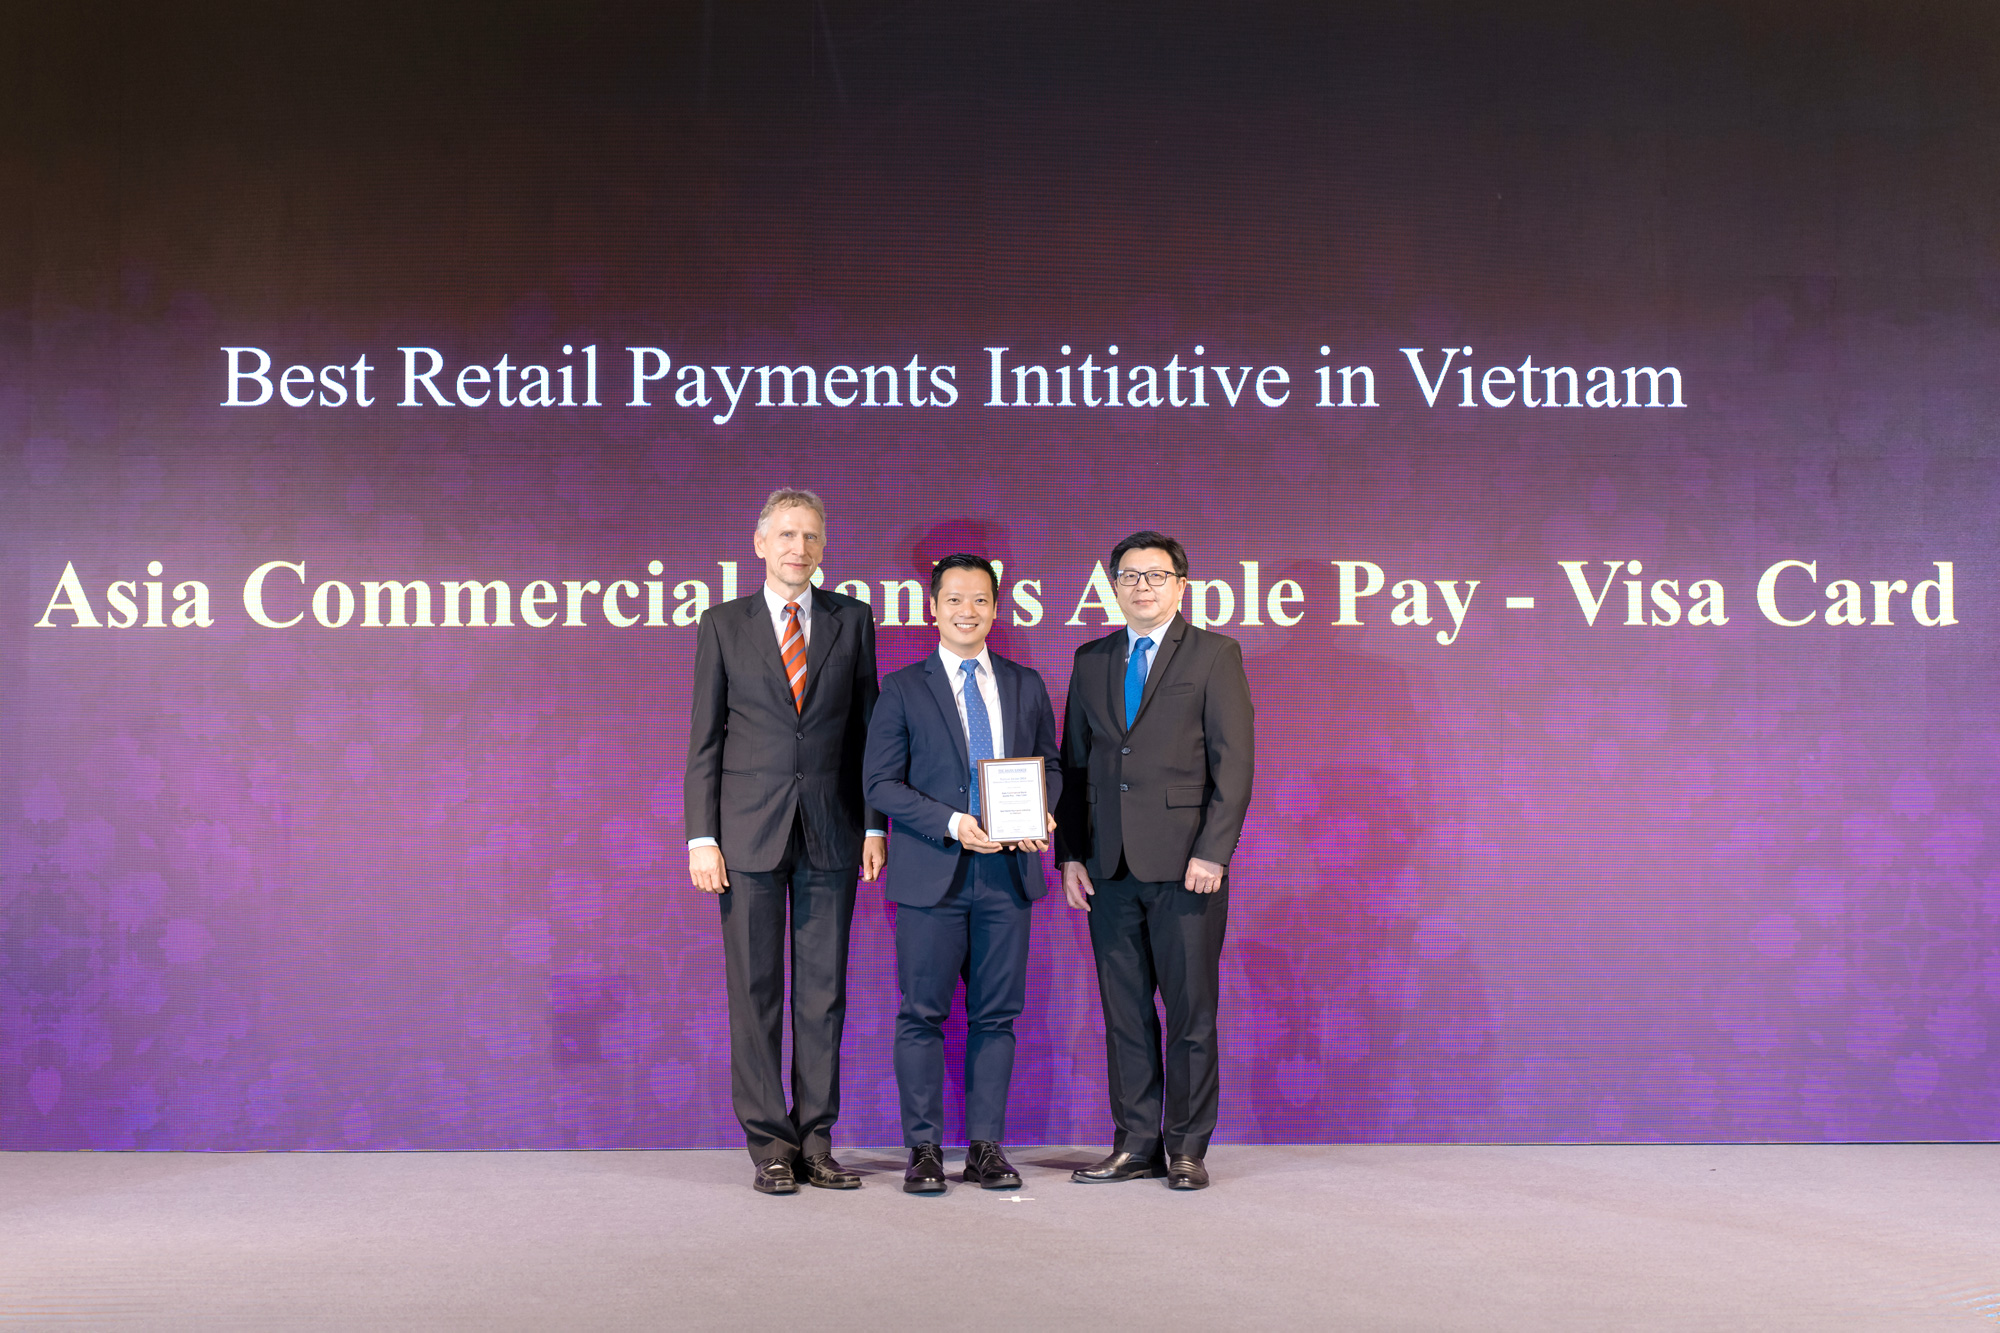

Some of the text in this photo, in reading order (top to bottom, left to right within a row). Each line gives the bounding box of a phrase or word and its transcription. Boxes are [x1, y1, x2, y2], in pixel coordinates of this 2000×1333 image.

[220, 345, 1687, 426] Best Retail Payments Initiative in Vietnam
[34, 559, 213, 629] Asia
[242, 559, 738, 629] Commercial
[1065, 559, 1305, 632] Aple
[1331, 559, 1480, 646] Pay
[1506, 596, 1535, 609] -
[1558, 559, 1729, 627] Visa
[1757, 559, 1959, 627] Card
